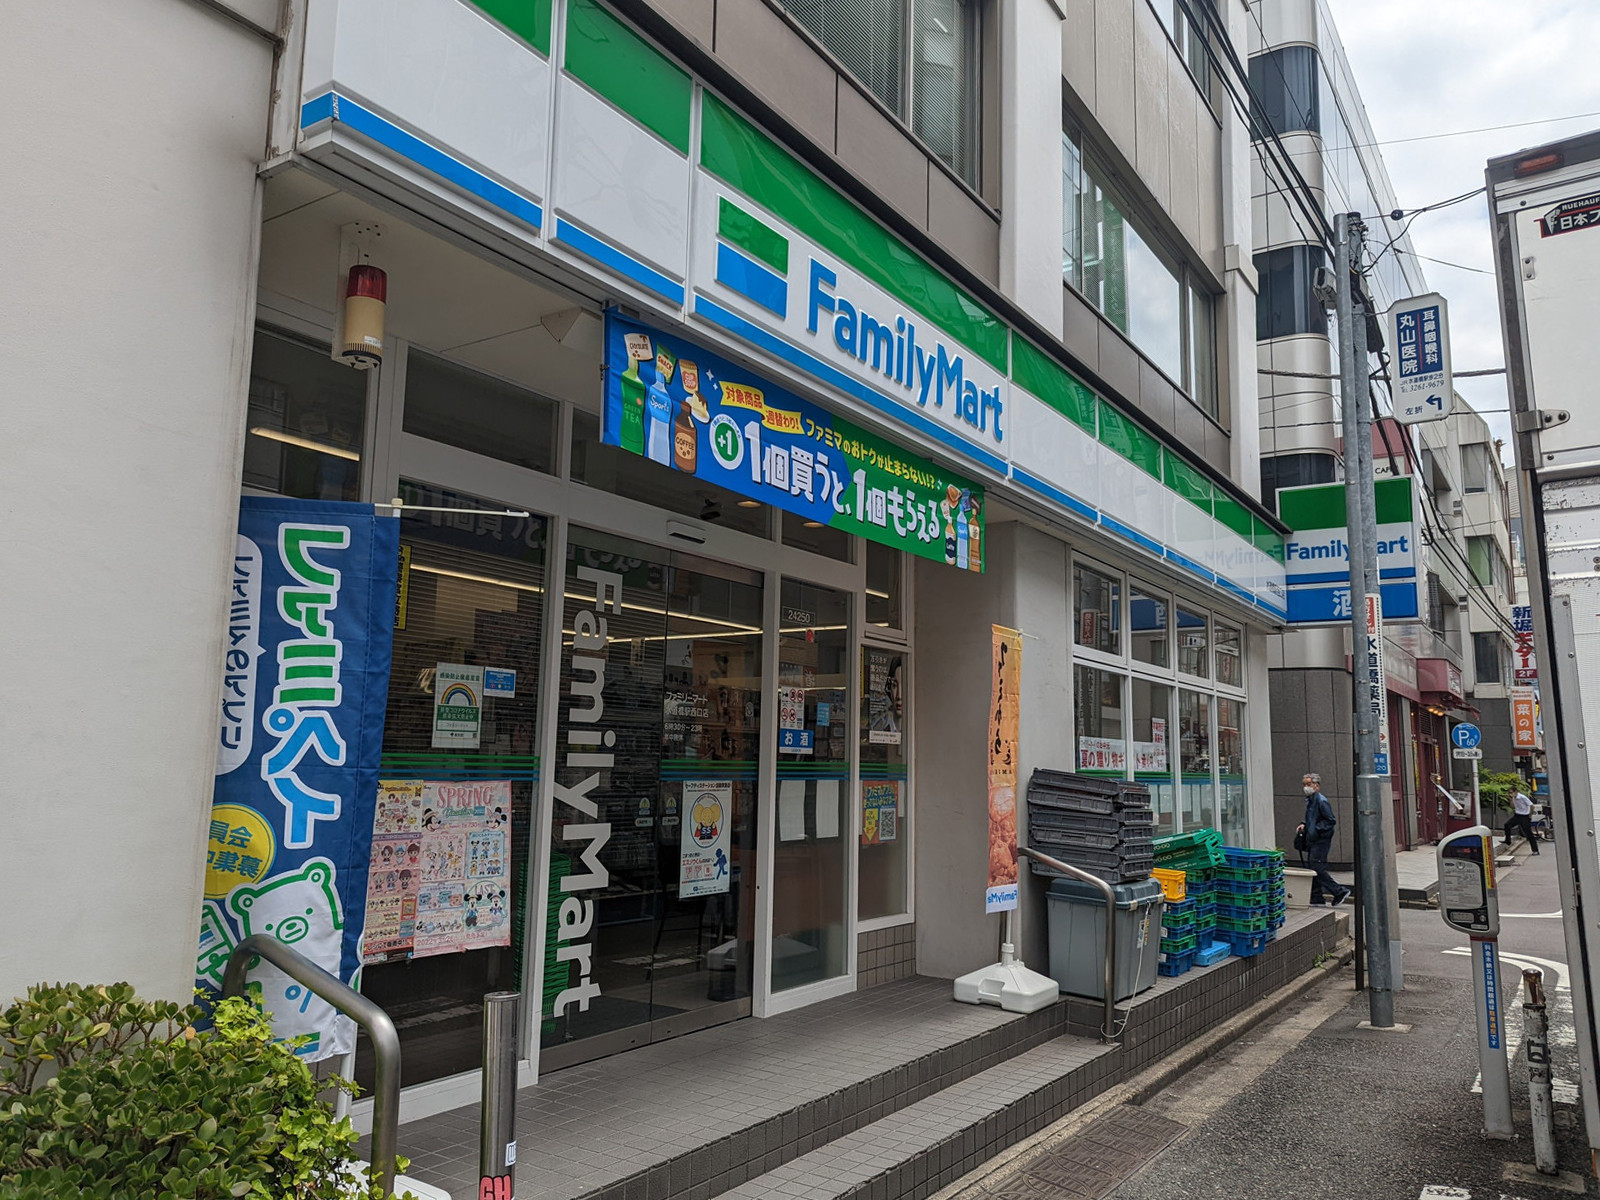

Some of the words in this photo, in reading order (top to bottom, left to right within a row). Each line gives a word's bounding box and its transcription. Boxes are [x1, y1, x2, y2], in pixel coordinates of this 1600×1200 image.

[1399, 314, 1418, 375] 丸山医院
[1423, 309, 1438, 365] 耳鼻咽喉科
[807, 256, 1004, 442] FamilyMart
[657, 355, 673, 372] SNACK
[650, 394, 669, 414] Sports
[725, 387, 763, 410] 対象商品
[624, 402, 641, 414] GREEN
[1404, 405, 1423, 416] 左折
[625, 412, 641, 424] TEA
[675, 436, 695, 451] COFFEE
[1287, 535, 1409, 562] Familyart
[787, 609, 811, 624] 24250
[1518, 670, 1535, 679] 2F
[666, 691, 709, 705] ファミリーマート
[1516, 703, 1532, 741] 菜の家
[784, 731, 809, 747] お酒
[1458, 729, 1470, 746] P
[436, 785, 494, 808] SPRING
[552, 565, 623, 1018] FamilyMart
